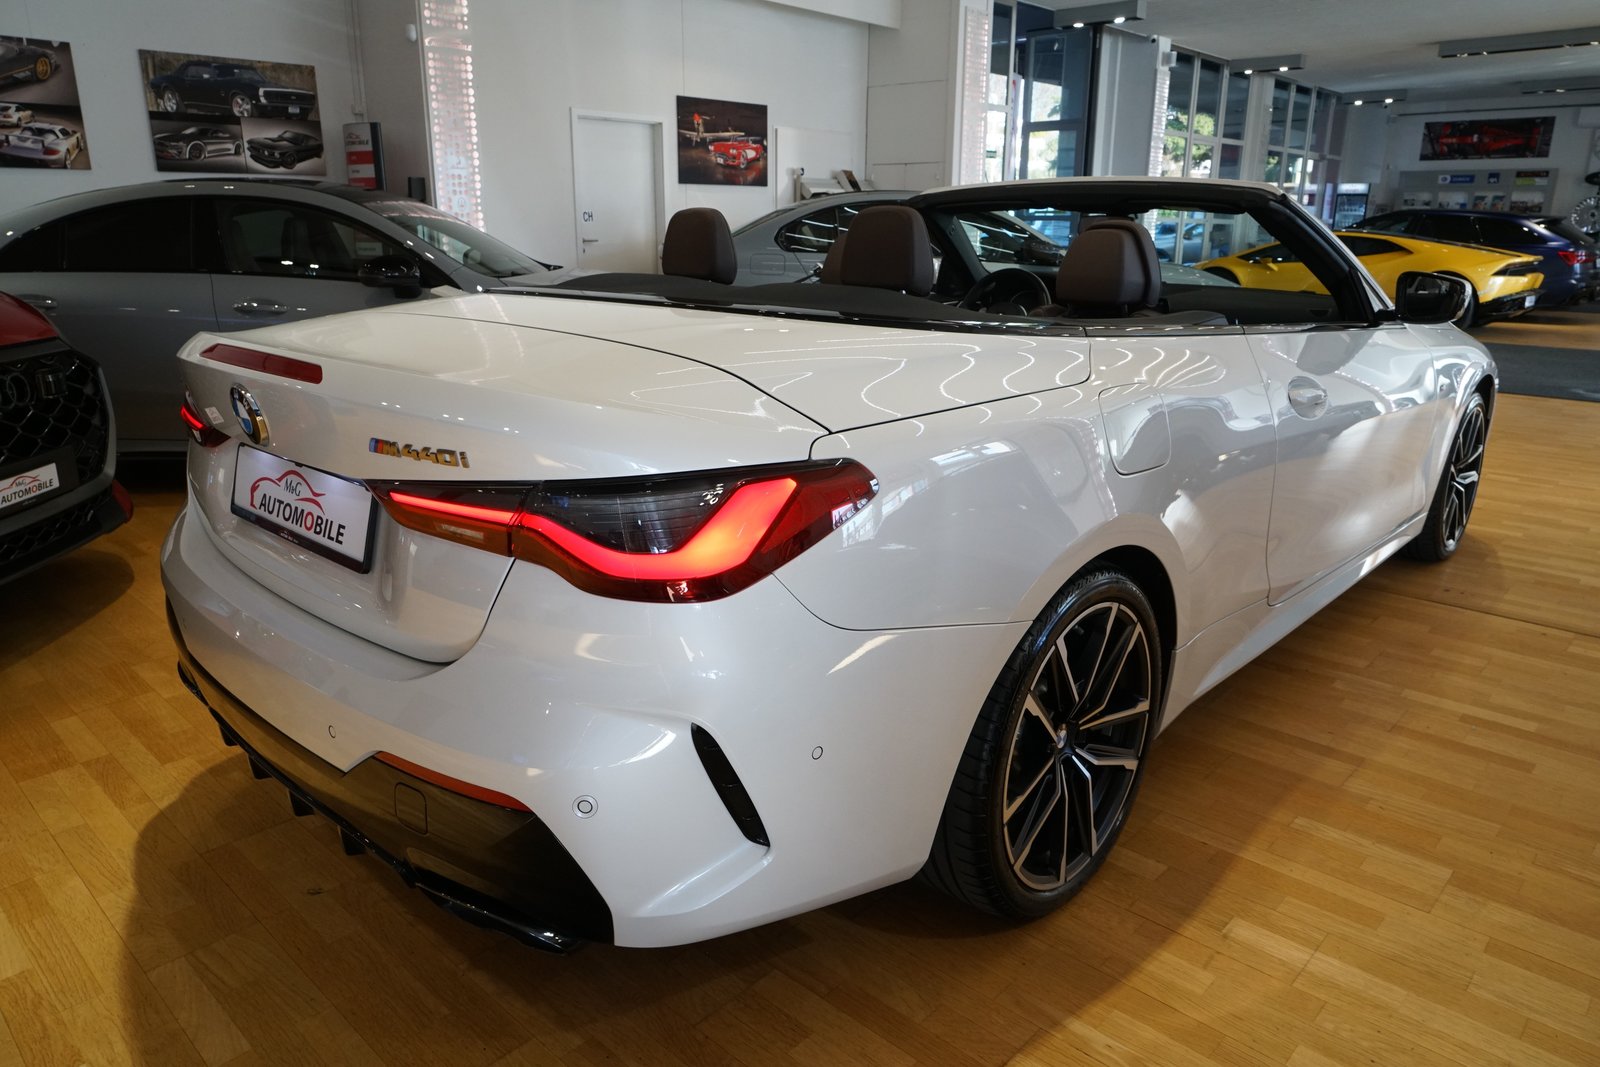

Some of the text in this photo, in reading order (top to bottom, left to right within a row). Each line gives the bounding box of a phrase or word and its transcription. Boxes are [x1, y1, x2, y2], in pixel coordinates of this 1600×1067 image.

[583, 211, 593, 222] CH
[369, 437, 470, 469] M440i
[1, 478, 54, 505] AUTOMOBILE
[284, 478, 303, 497] M&G
[258, 493, 346, 545] AUTOMOBILE
